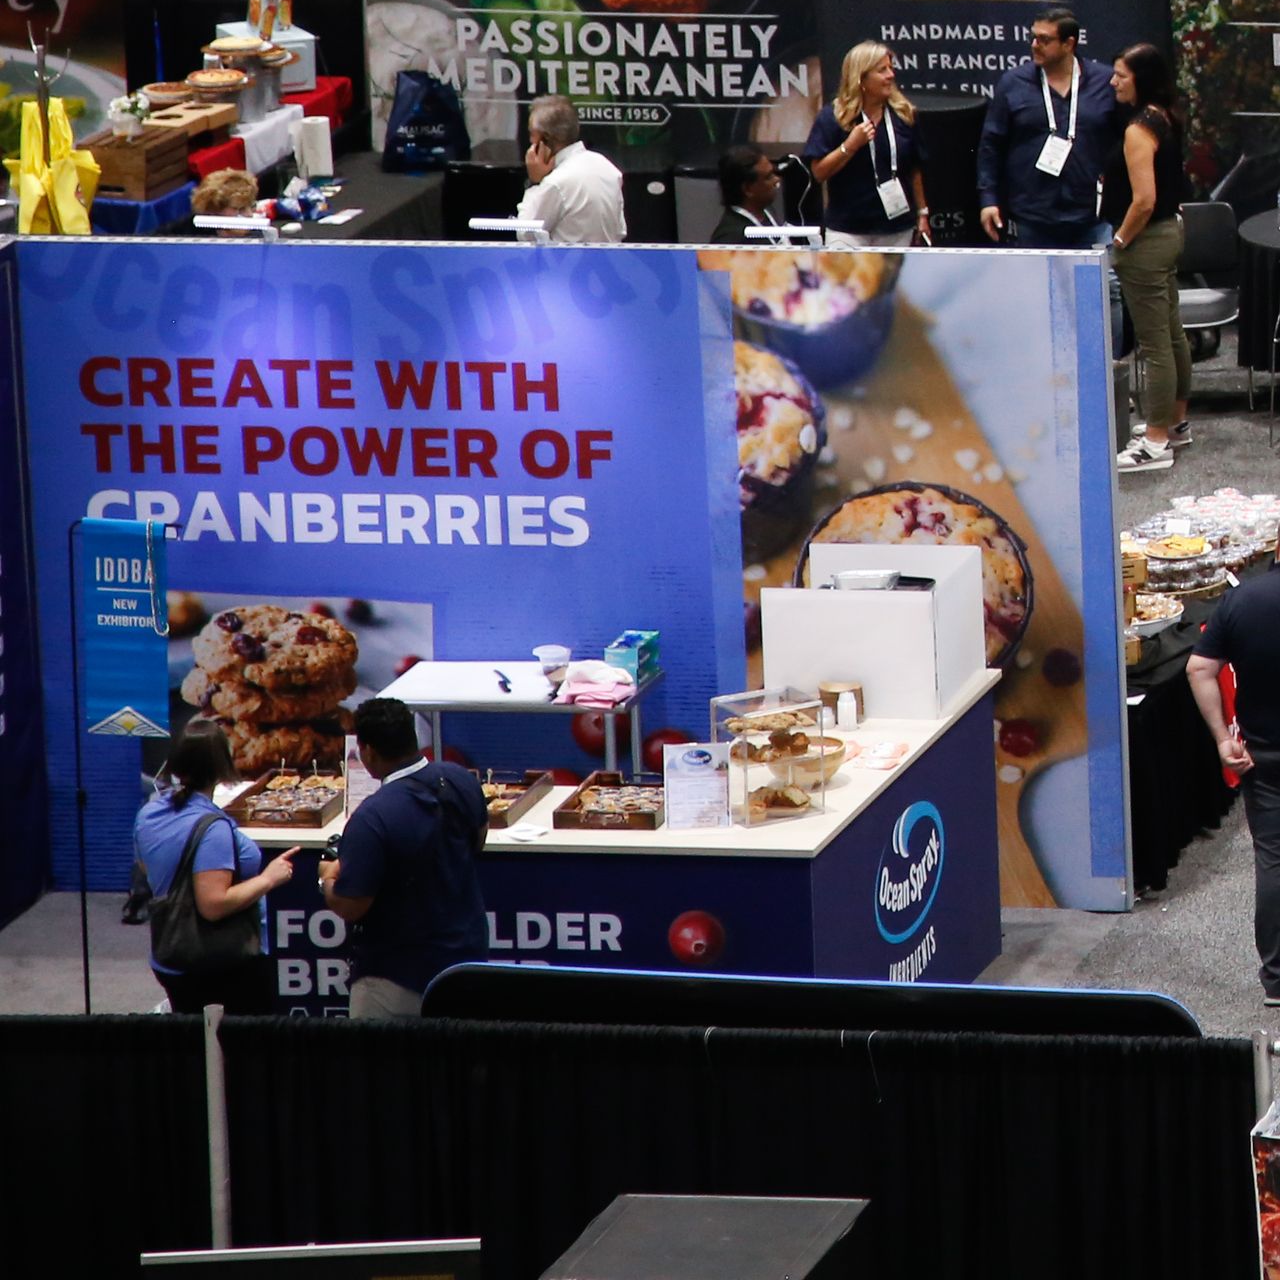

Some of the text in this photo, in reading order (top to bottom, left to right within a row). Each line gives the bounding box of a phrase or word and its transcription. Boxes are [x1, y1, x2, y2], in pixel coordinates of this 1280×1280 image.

[456, 22, 779, 60] PASSIONATELY
[881, 23, 1006, 41] HANDMADE
[425, 56, 809, 100] MEDITERRANEAN
[928, 54, 1033, 71] FRANCISC
[578, 104, 660, 121] SINCE 1956
[79, 356, 559, 412] CREATE WITH
[80, 423, 614, 480] THE POWER OF
[95, 557, 155, 584] IDDBA
[112, 598, 138, 610] NEW
[97, 614, 156, 628] EXHIBITOR
[879, 828, 939, 913] Ocean Spray
[888, 925, 937, 983] INGREDIENTS
